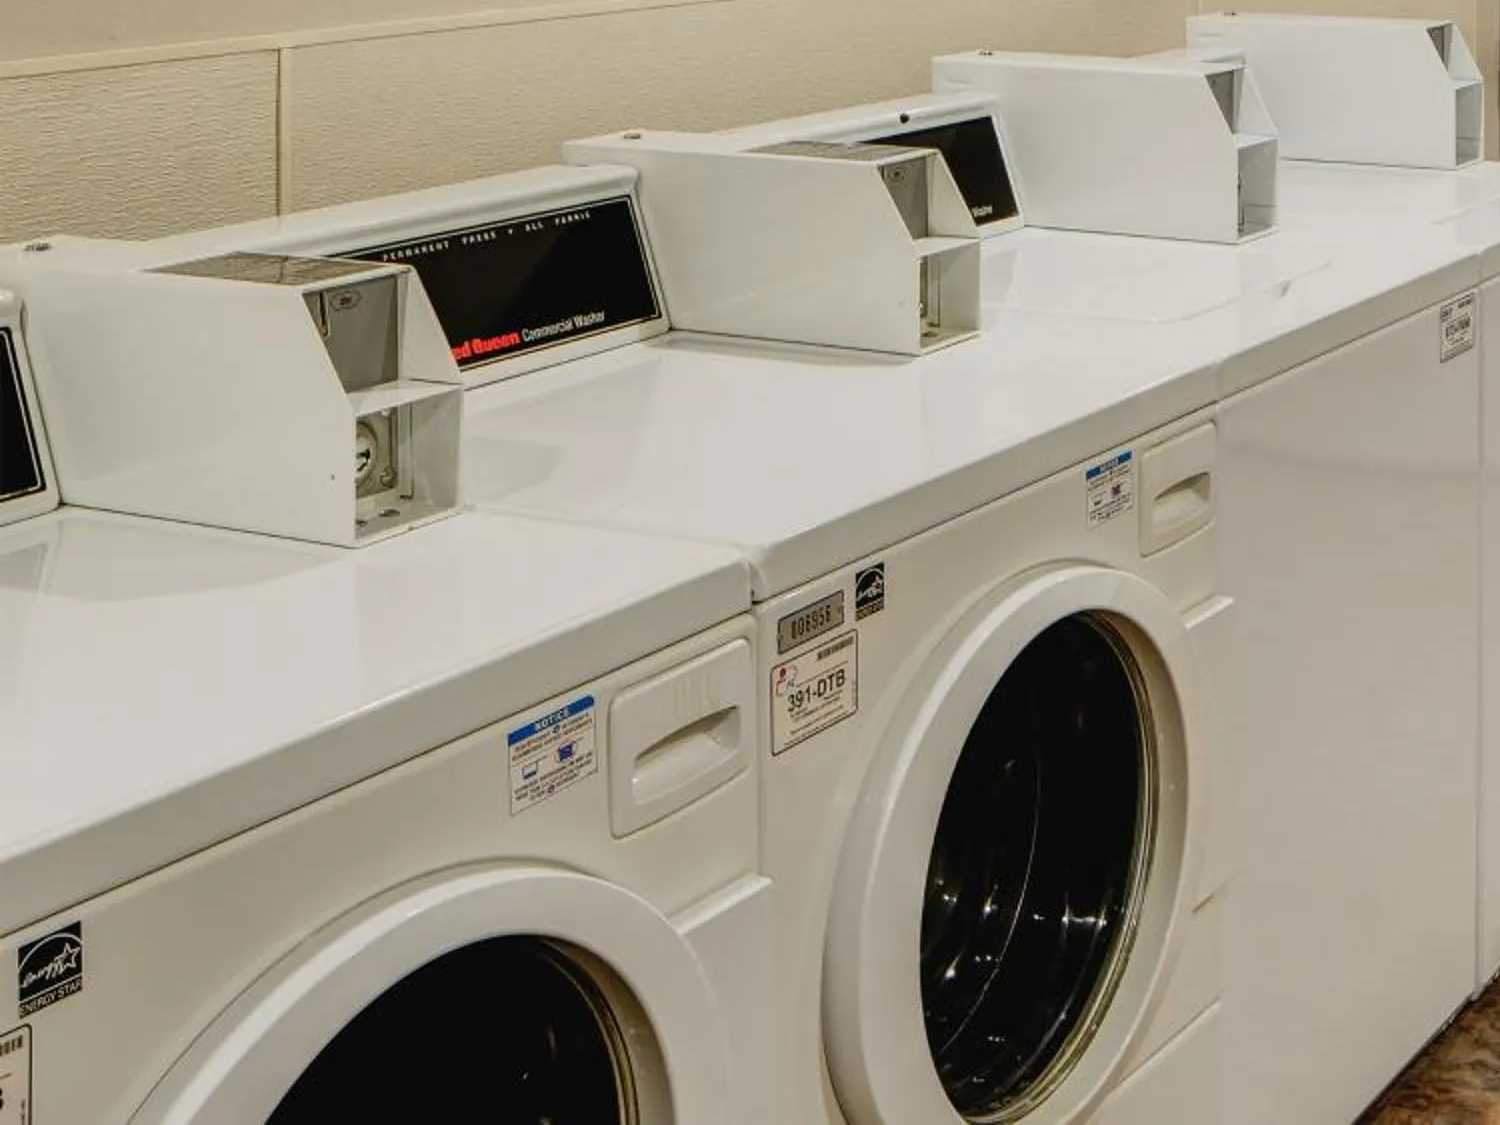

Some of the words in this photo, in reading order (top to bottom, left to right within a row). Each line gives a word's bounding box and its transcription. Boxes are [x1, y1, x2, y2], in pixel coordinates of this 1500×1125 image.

[471, 332, 521, 354] Queen
[521, 317, 573, 342] Commercial
[573, 310, 605, 328] Washer
[788, 668, 846, 713] 391-DTB
[19, 990, 56, 1016] ENERGY
[58, 977, 82, 999] STAR
